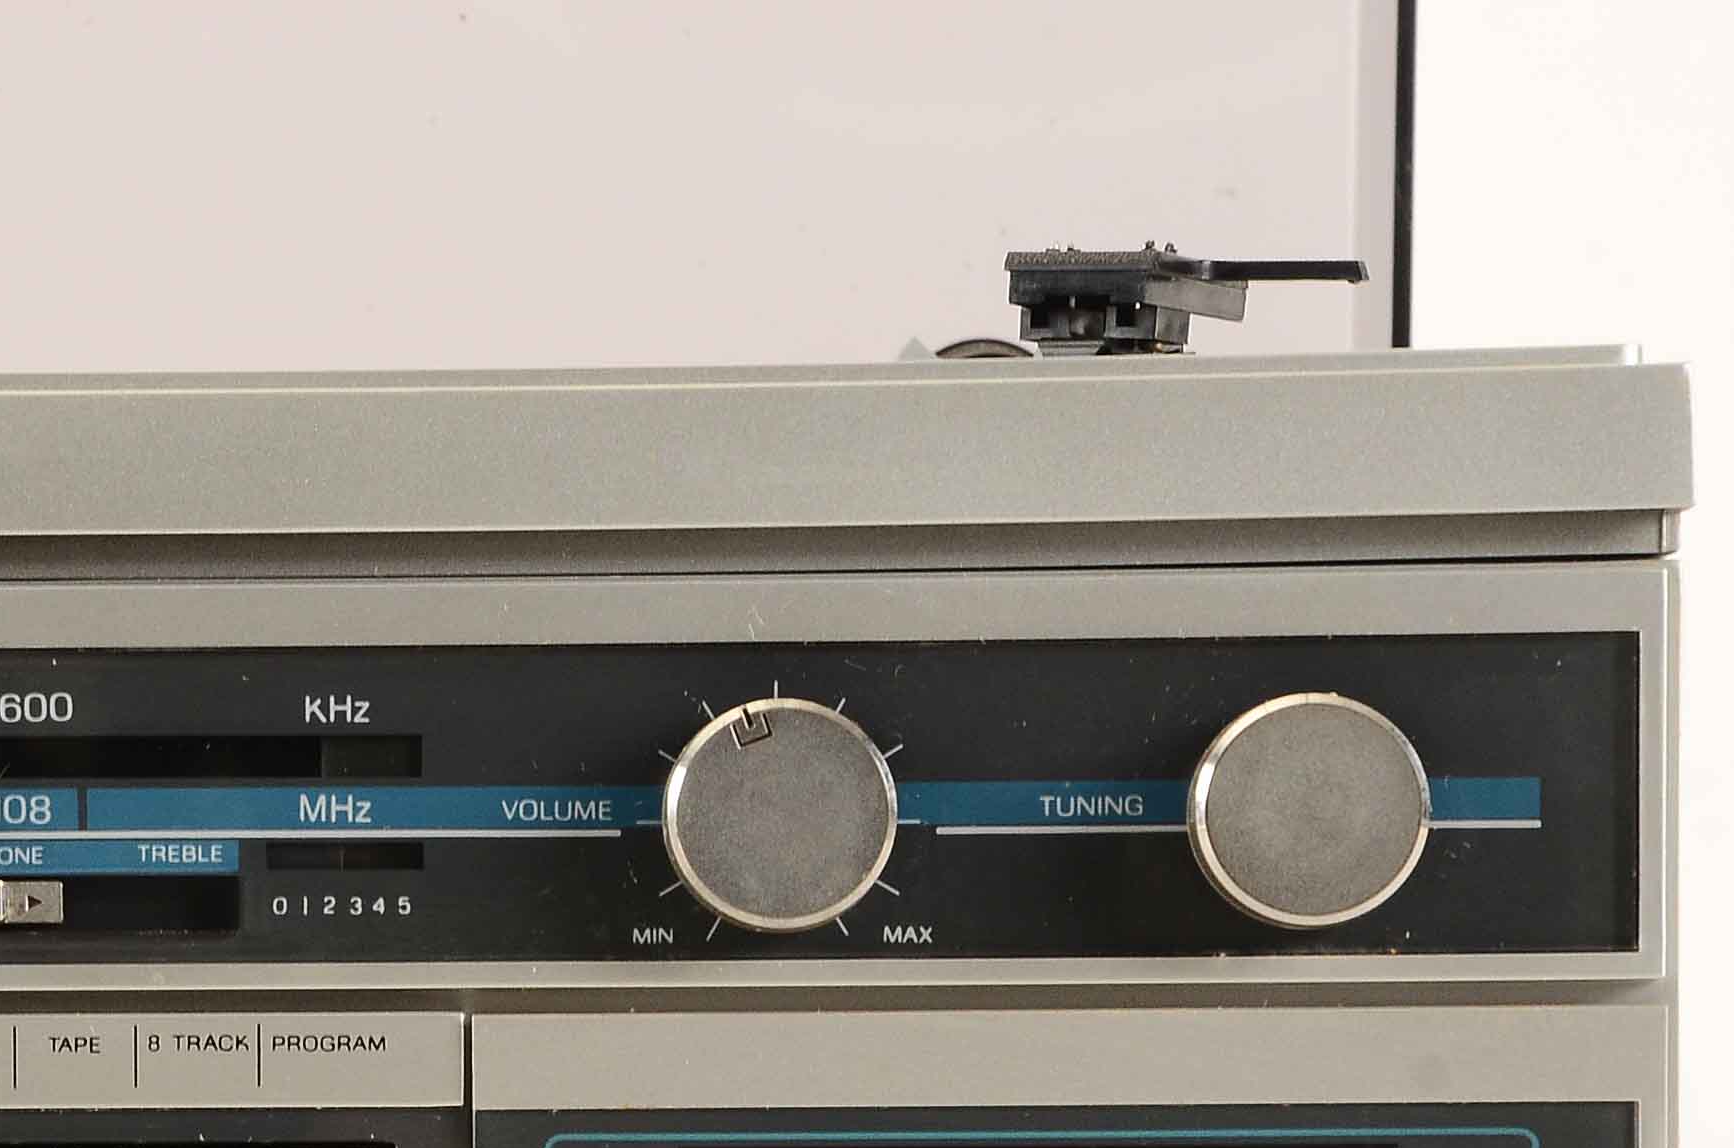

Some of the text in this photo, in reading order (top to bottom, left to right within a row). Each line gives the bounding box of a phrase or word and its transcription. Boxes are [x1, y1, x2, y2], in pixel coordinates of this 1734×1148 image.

[304, 694, 370, 723] KHz
[299, 793, 372, 823] MHz
[501, 799, 611, 821] VOLUME
[1039, 795, 1143, 817] TUNING
[137, 844, 223, 863] TREBLE
[632, 927, 674, 945] MIN
[883, 925, 933, 944] MAX
[49, 1036, 101, 1054] TAPE
[148, 1034, 249, 1052] 8 TRACK
[272, 1034, 386, 1053] PROGRAM
